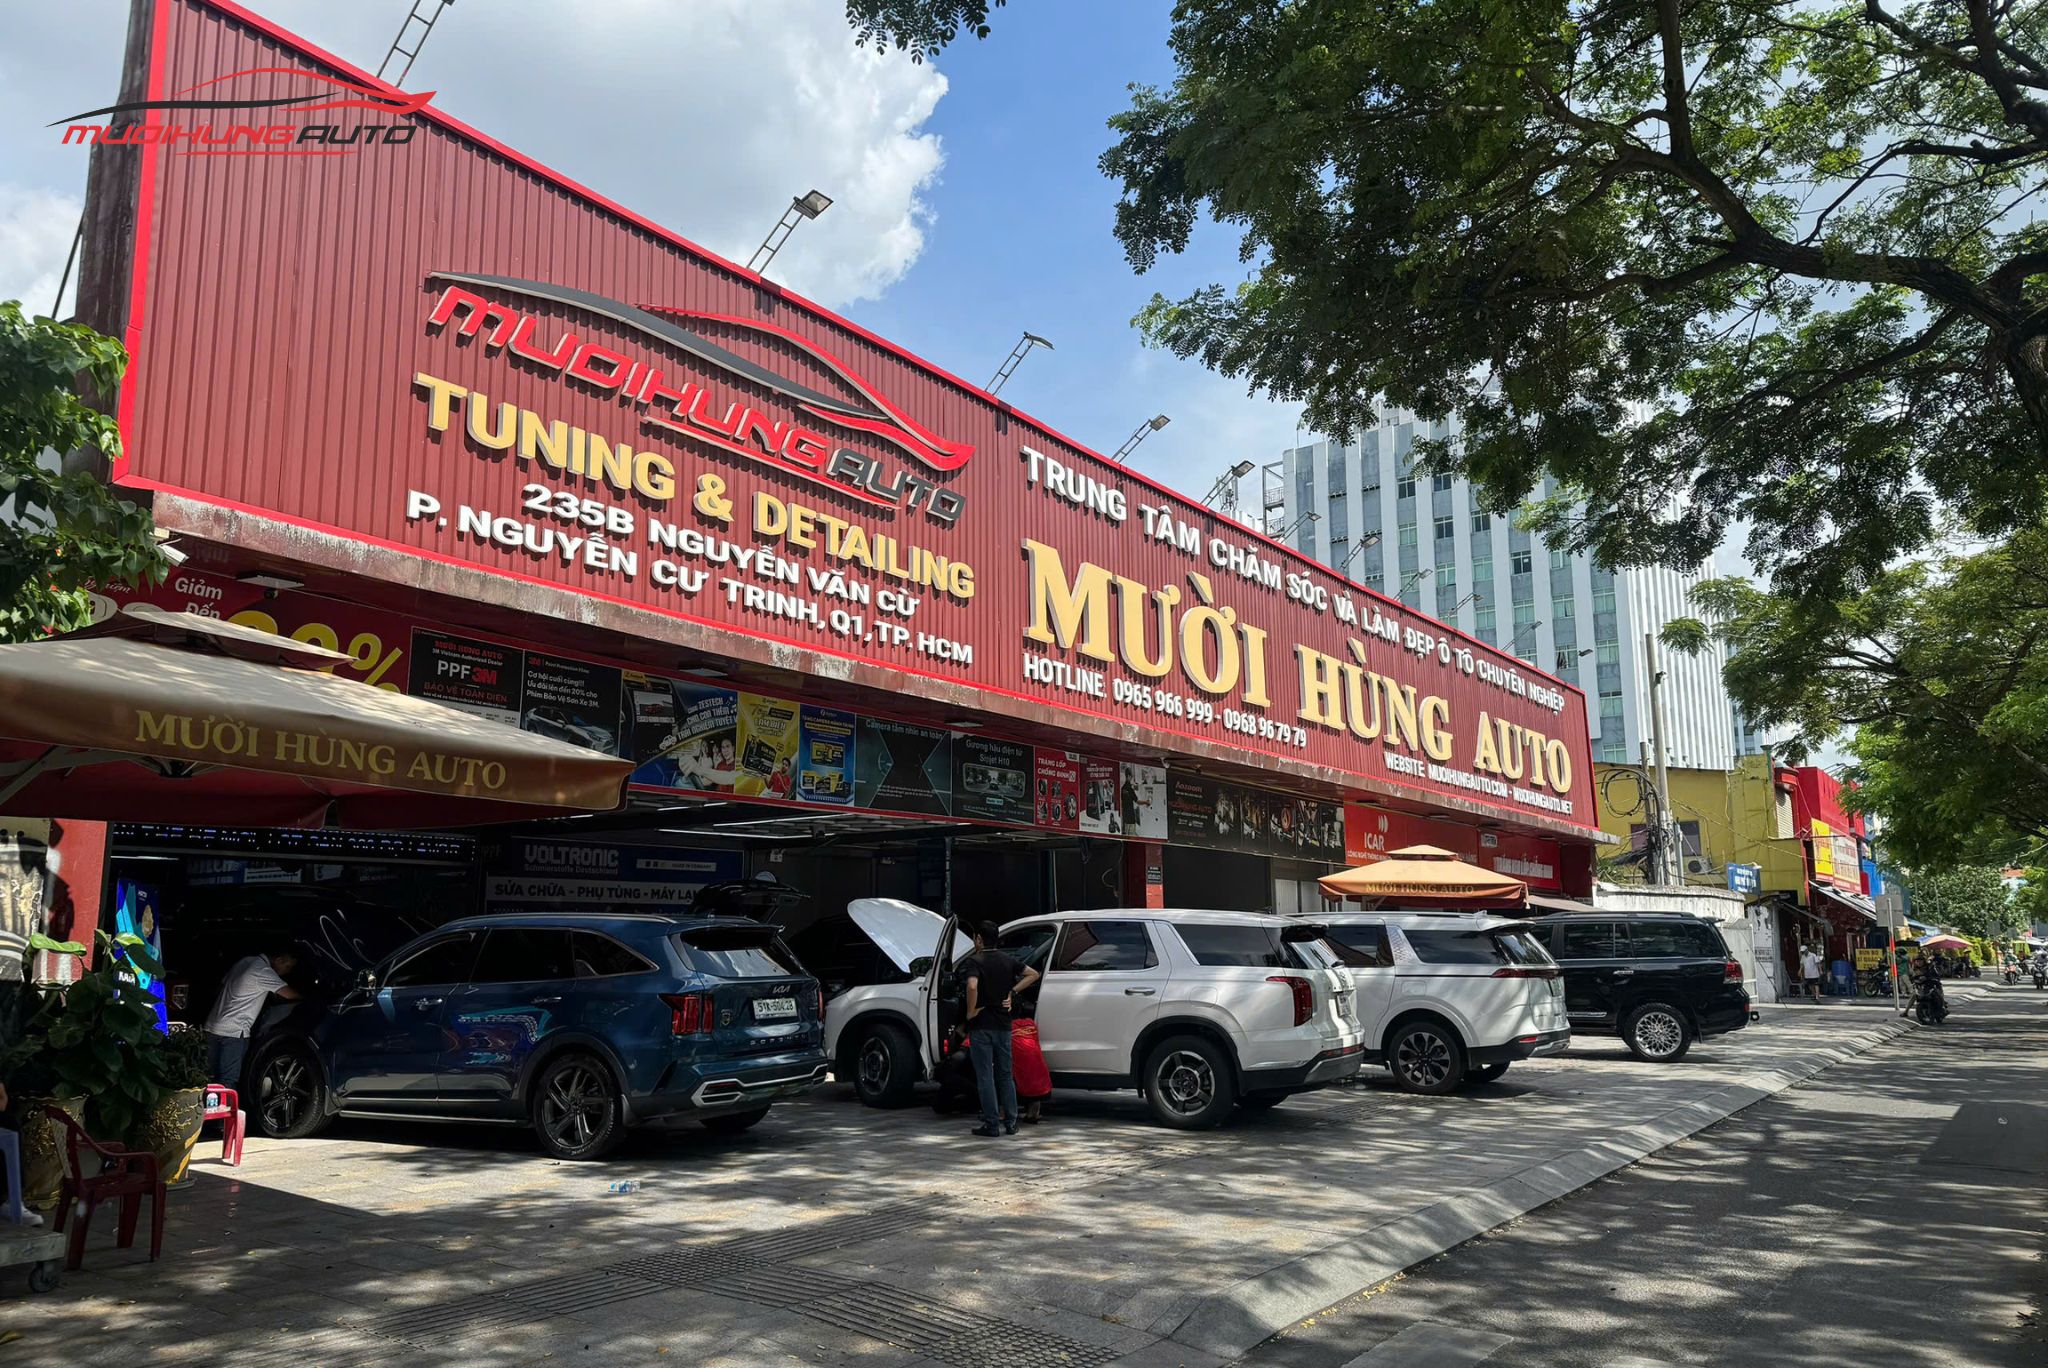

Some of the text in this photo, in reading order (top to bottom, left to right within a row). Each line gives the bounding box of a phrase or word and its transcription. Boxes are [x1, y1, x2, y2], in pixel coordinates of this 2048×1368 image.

[412, 373, 975, 599] TUNING & DETAILING
[523, 483, 920, 616] 235B NGUYỄN VĂN CỪ
[175, 577, 222, 600] Giảm
[406, 489, 448, 527] P.
[457, 504, 638, 577] NGUYỄN
[650, 559, 710, 593] CƯ
[720, 577, 826, 630] TRINH,
[917, 631, 973, 664] HCM
[1020, 445, 1565, 716] TRUNG TÂM CHĂM SÓC VÀ LÀM ĐẸP Ô TÔ CHUYÊN NGHIỆP
[437, 659, 497, 685] PPF 3M
[1022, 538, 1573, 794] MƯỜI HÙNG AUTO
[866, 719, 891, 731] Camera
[1113, 677, 1152, 709] 0965
[1154, 690, 1182, 717] 966
[1186, 698, 1213, 724] 999
[1223, 708, 1257, 735] 0968
[1292, 726, 1307, 747] 79
[136, 710, 506, 789] MƯỜI HÙNG AUTO
[998, 757, 1010, 766] H10
[1364, 832, 1385, 851] ICAR
[524, 844, 619, 867] VOLTRONIC
[495, 880, 524, 897] SỬA
[528, 882, 566, 897] CHỮA
[577, 886, 604, 900] PHỤ
[608, 884, 641, 899] TÙNG
[650, 886, 676, 900] MÁY
[1400, 881, 1438, 894] HÙNG
[1440, 884, 1474, 894] AUTO
